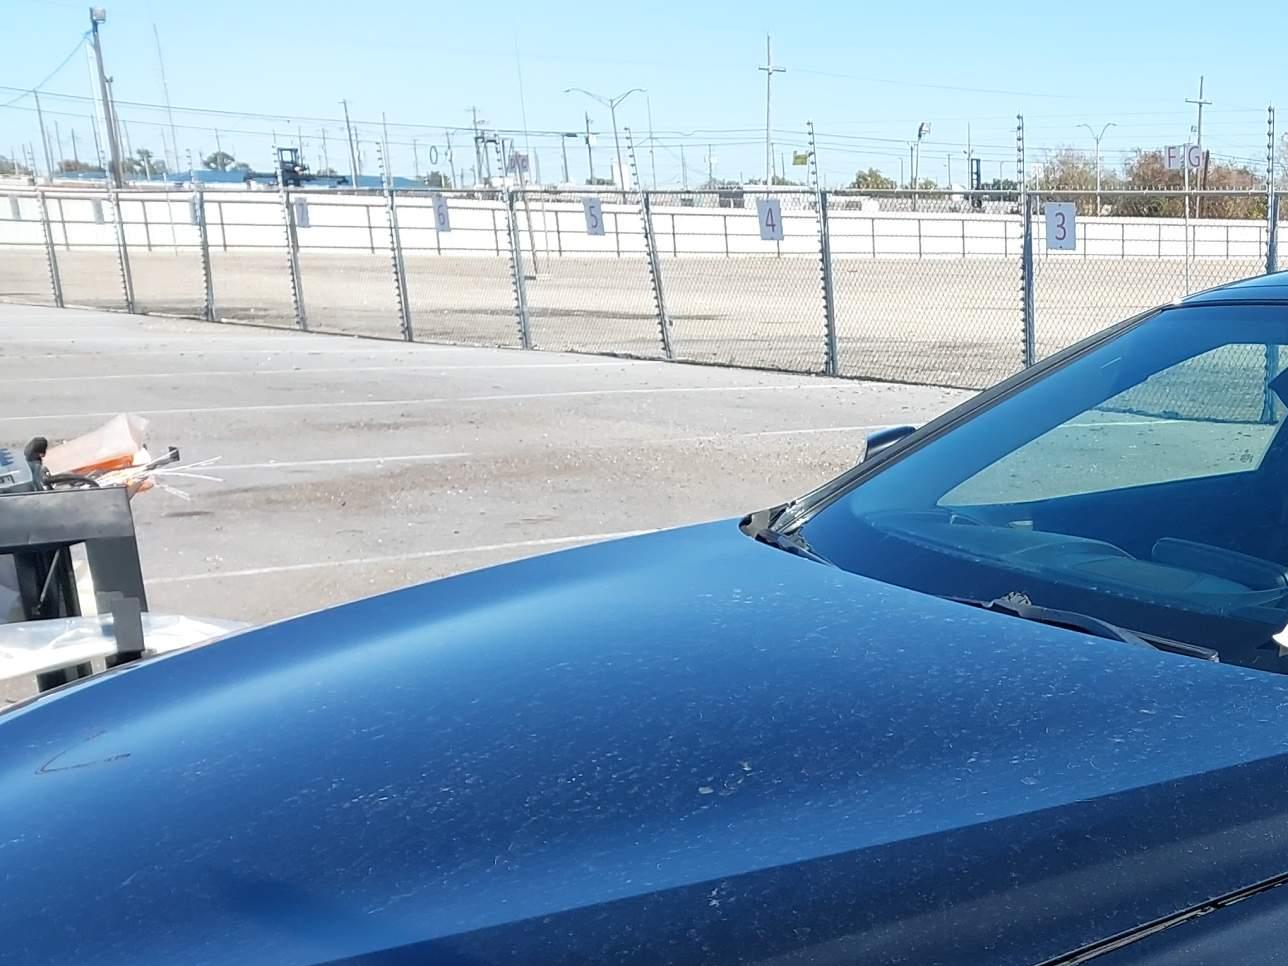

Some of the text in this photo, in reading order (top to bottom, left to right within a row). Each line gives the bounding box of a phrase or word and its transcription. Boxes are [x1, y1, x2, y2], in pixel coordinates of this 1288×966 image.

[1167, 146, 1176, 168] F
[1188, 146, 1201, 167] G
[437, 205, 446, 226] 6
[589, 205, 598, 228] 5
[765, 207, 776, 232] 4
[1055, 212, 1067, 241] 3
